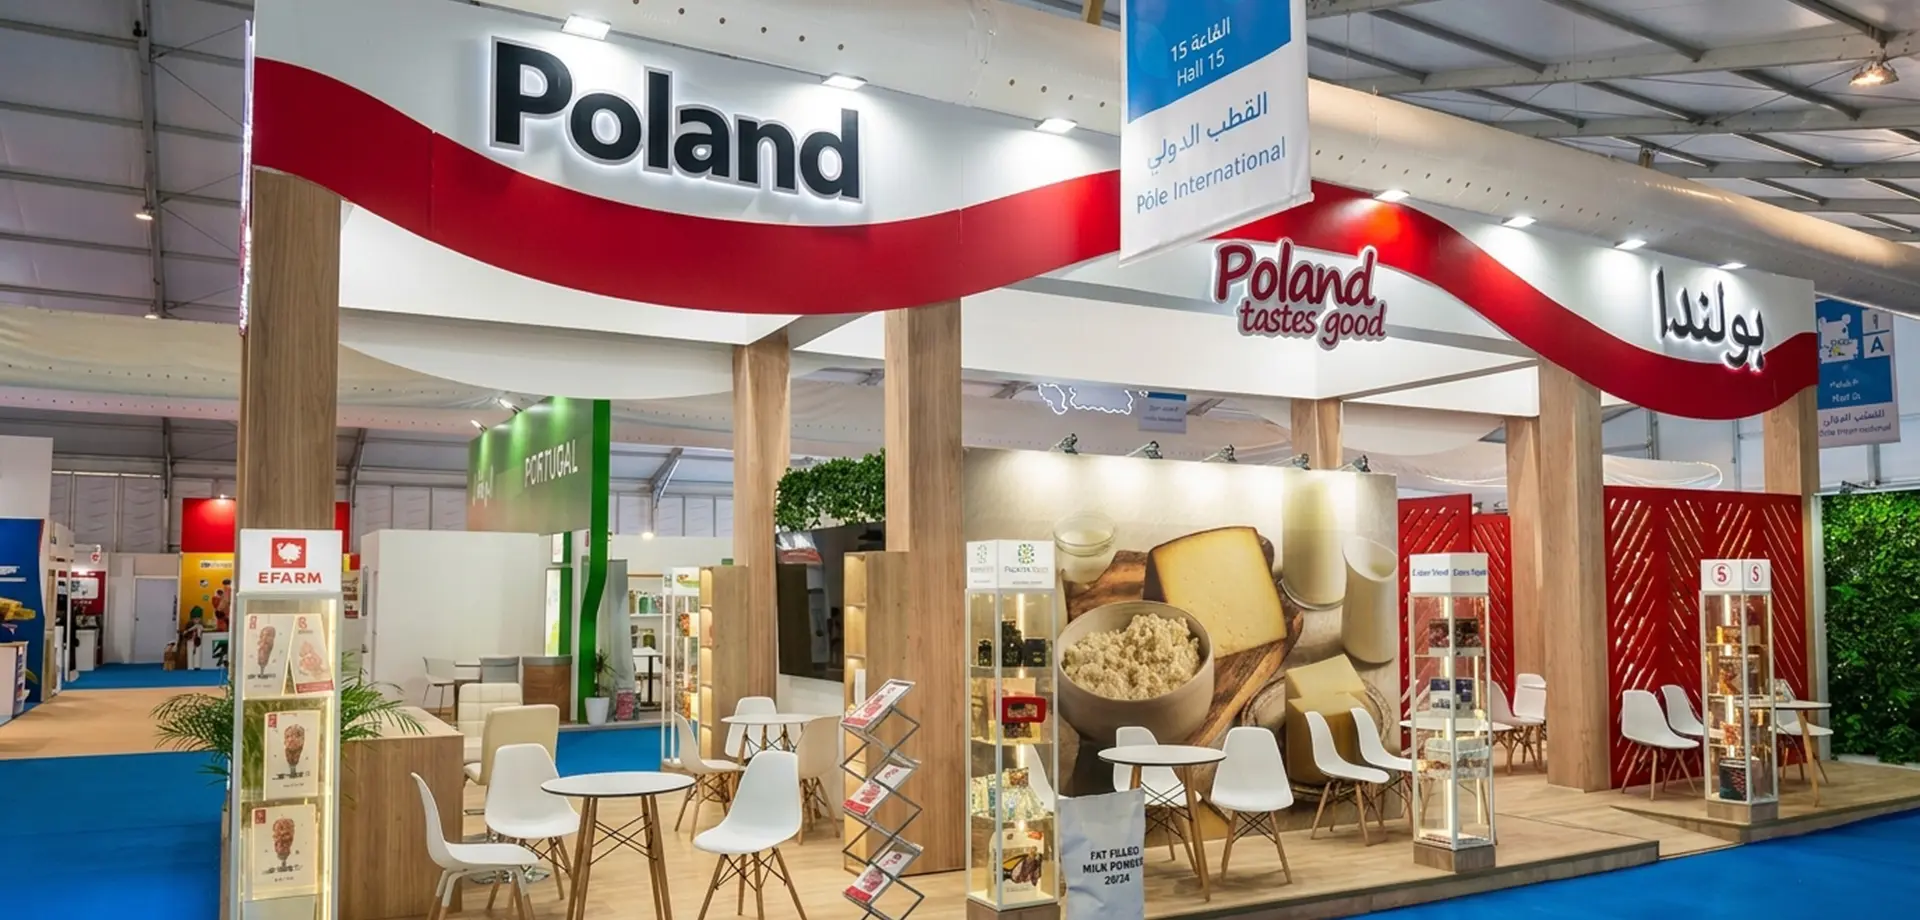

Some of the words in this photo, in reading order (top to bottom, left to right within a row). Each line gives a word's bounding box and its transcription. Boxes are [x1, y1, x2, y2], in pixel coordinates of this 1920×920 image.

[1170, 40, 1188, 62] 15
[1177, 58, 1204, 88] Hall
[1208, 48, 1225, 70] 15
[493, 38, 861, 202] Poland
[1206, 91, 1268, 142] القطب
[1147, 122, 1200, 176] الدولي
[1174, 136, 1286, 200] International
[1215, 240, 1377, 307] Poland
[1239, 300, 1318, 335] tastes
[1322, 302, 1387, 346] good
[1656, 265, 1765, 371] بولندا
[1870, 335, 1885, 354] A
[524, 439, 579, 488] PORTUGAL
[258, 572, 322, 584] EFARM
[1082, 863, 1108, 874] MILK
[1090, 850, 1107, 860] FAT
